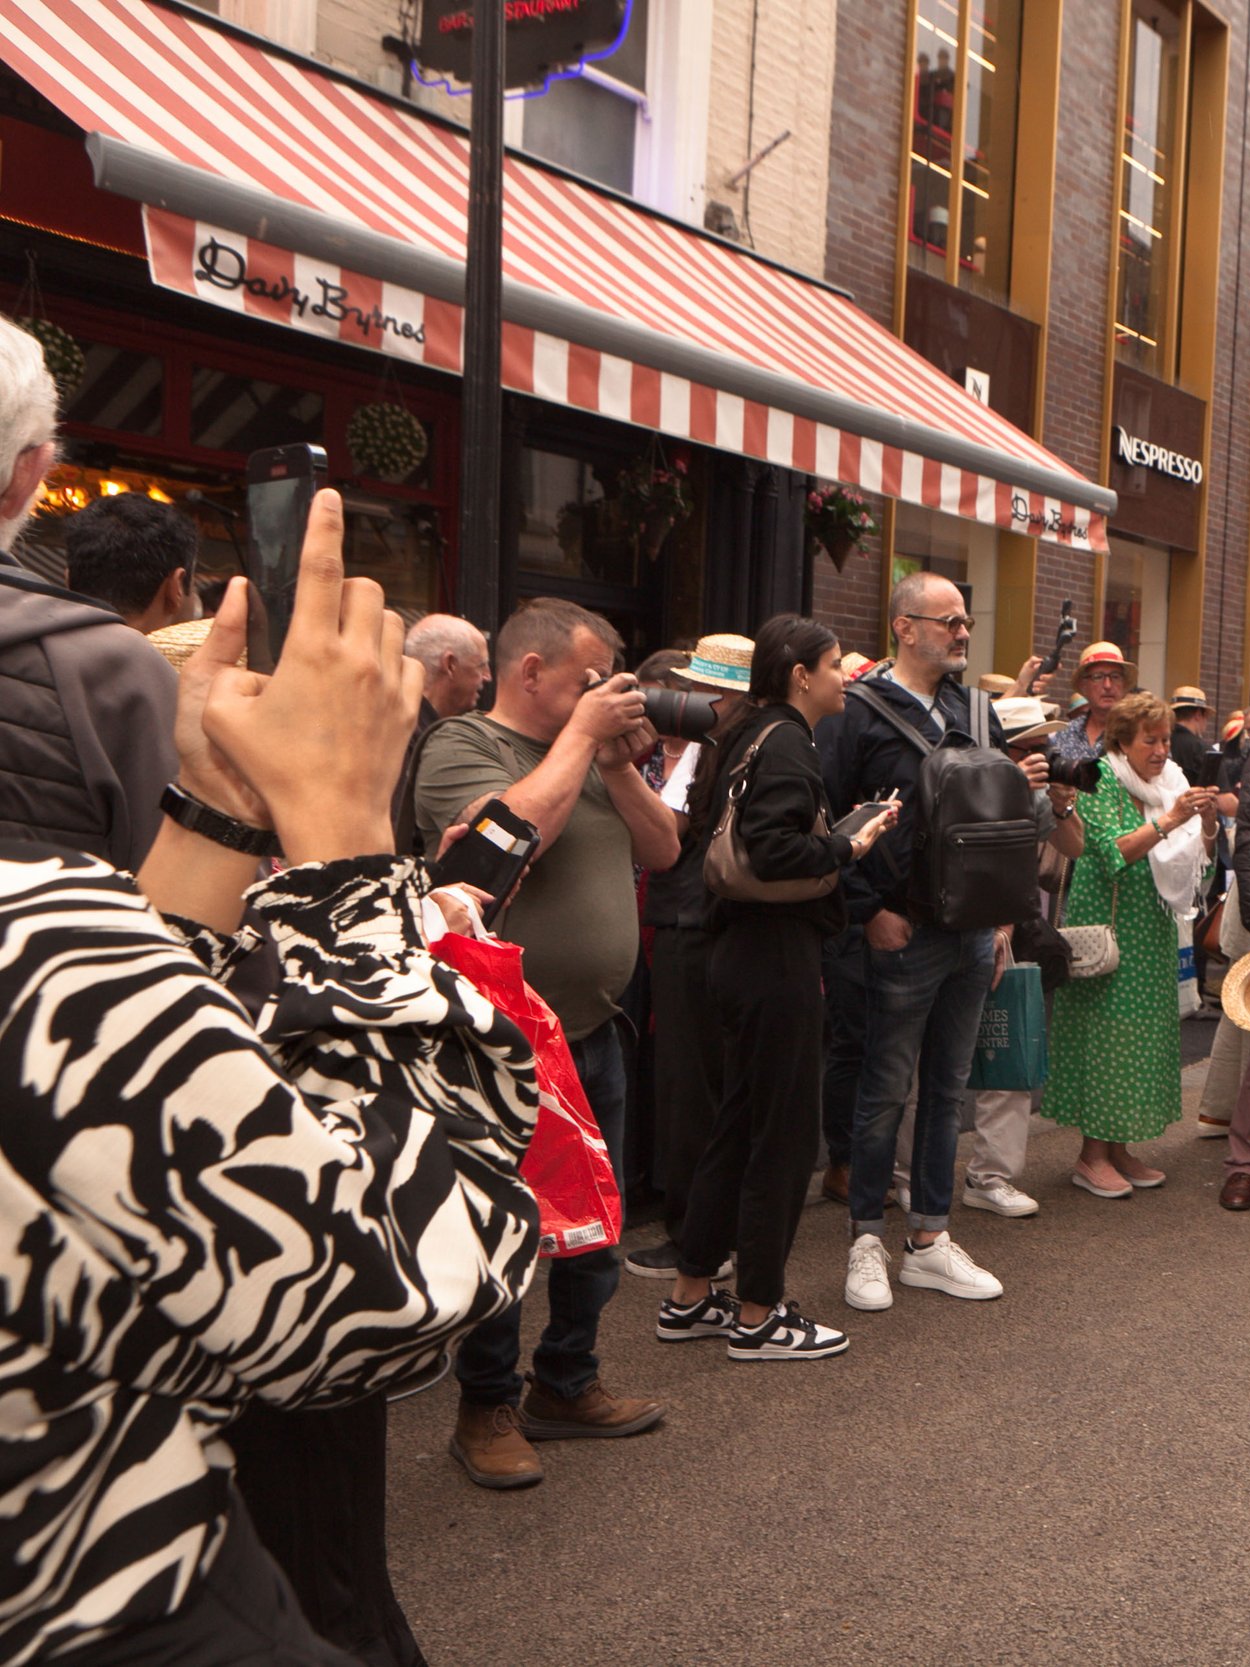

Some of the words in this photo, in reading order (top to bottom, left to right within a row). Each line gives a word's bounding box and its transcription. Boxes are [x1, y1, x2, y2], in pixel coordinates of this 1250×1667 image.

[195, 236, 308, 317] Davy
[312, 277, 426, 344] Byrnes
[1118, 425, 1203, 484] NESPRESSO
[1012, 495, 1049, 533] Davy
[981, 1009, 1008, 1022] MES
[978, 1023, 1008, 1036] OYCE
[977, 1037, 1010, 1048] ENTRE
